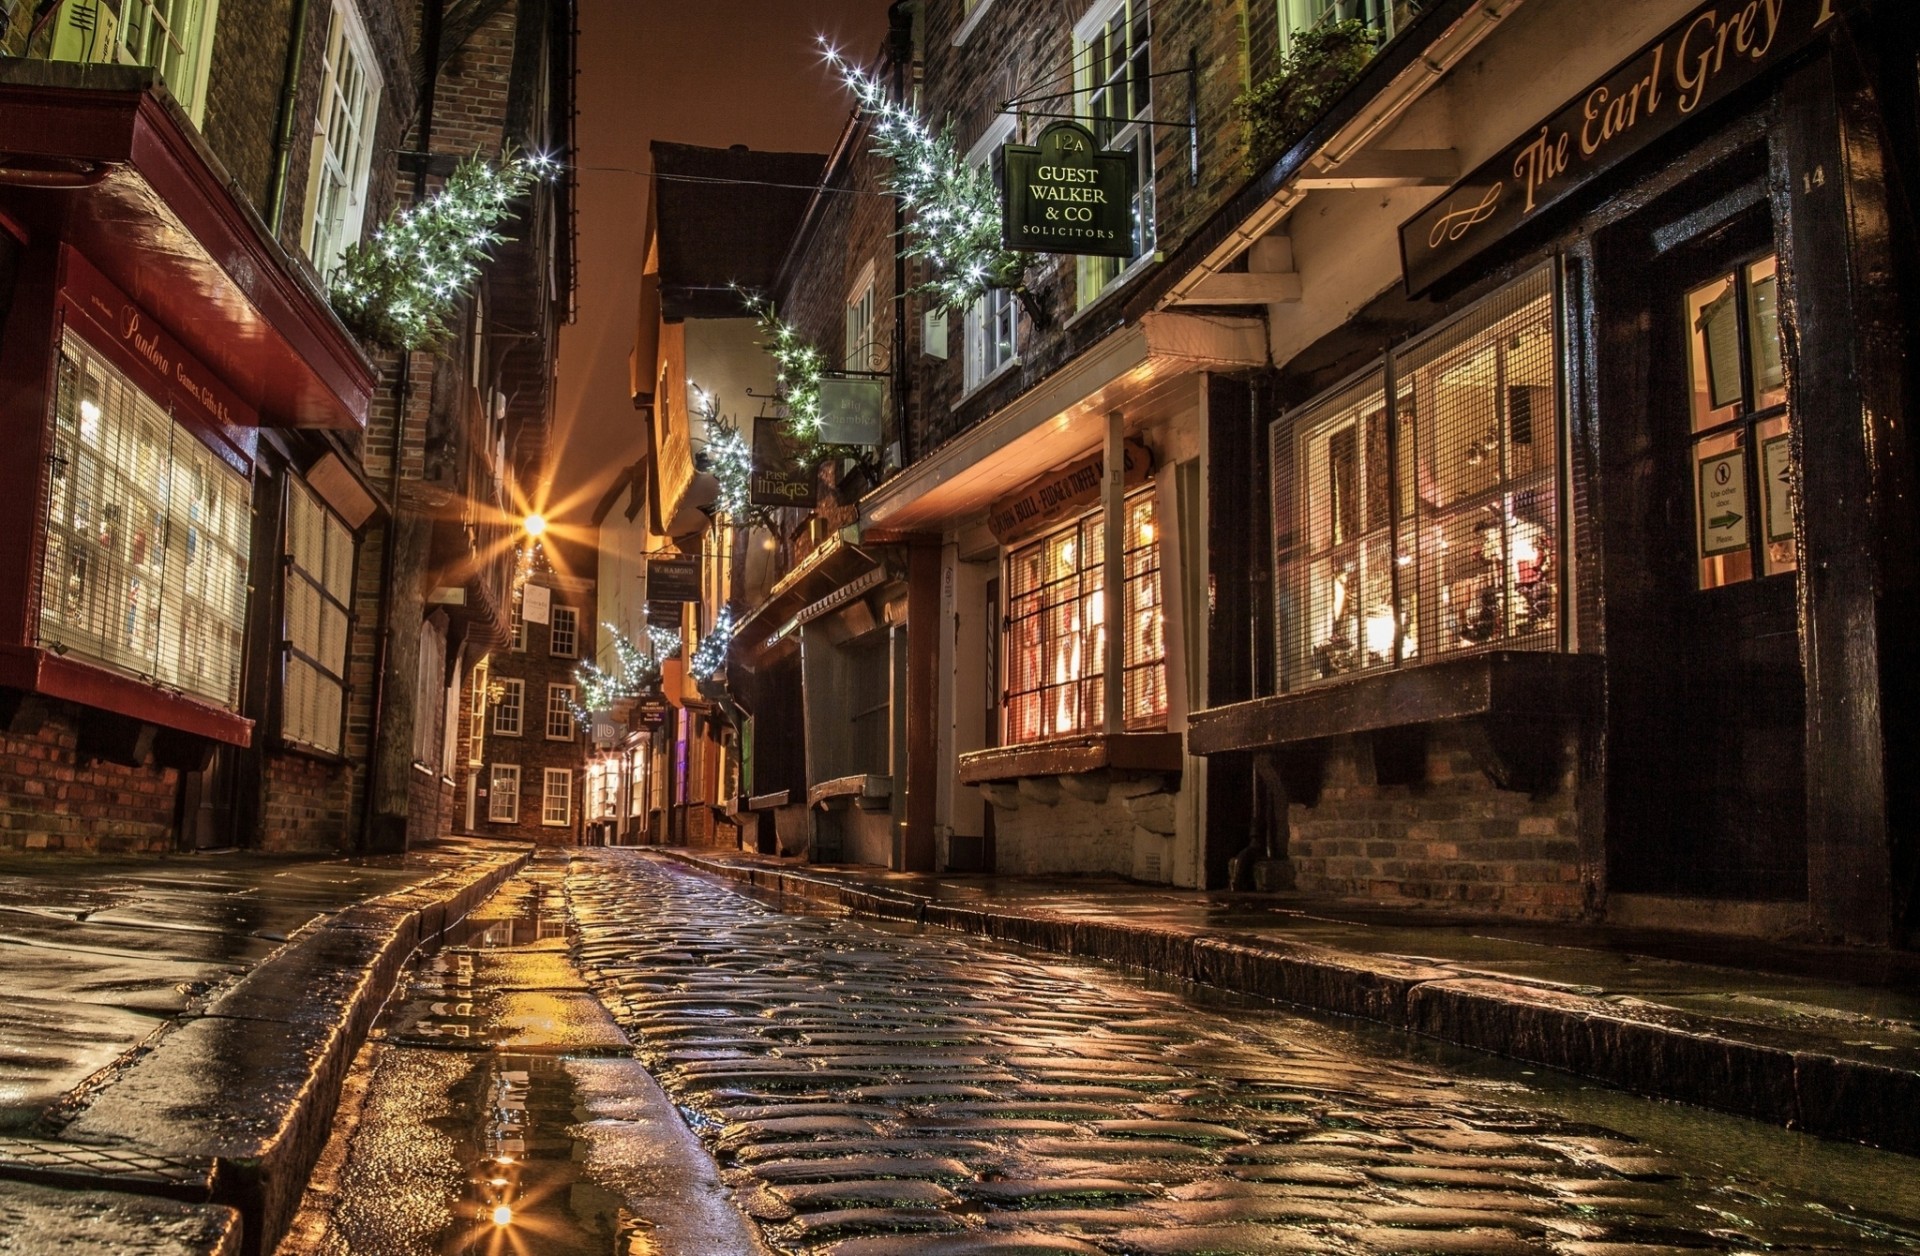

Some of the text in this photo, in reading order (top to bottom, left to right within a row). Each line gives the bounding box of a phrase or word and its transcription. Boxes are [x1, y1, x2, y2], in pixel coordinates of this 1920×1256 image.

[1513, 0, 1782, 213] The Earl Grey
[1054, 133, 1084, 152] 12A
[1038, 166, 1098, 184] GUEST
[1803, 164, 1826, 195] 14
[1029, 184, 1108, 204] WALKER
[1045, 206, 1093, 222] & CO
[1022, 225, 1114, 239] SOLICITORS
[120, 304, 170, 376] Pandora
[765, 470, 788, 481] Past
[996, 508, 1017, 534] JOHN
[1014, 495, 1039, 522] BULL
[1039, 481, 1065, 509] FUDGE
[1068, 464, 1098, 494] TOFFEE
[1721, 487, 1736, 496] other
